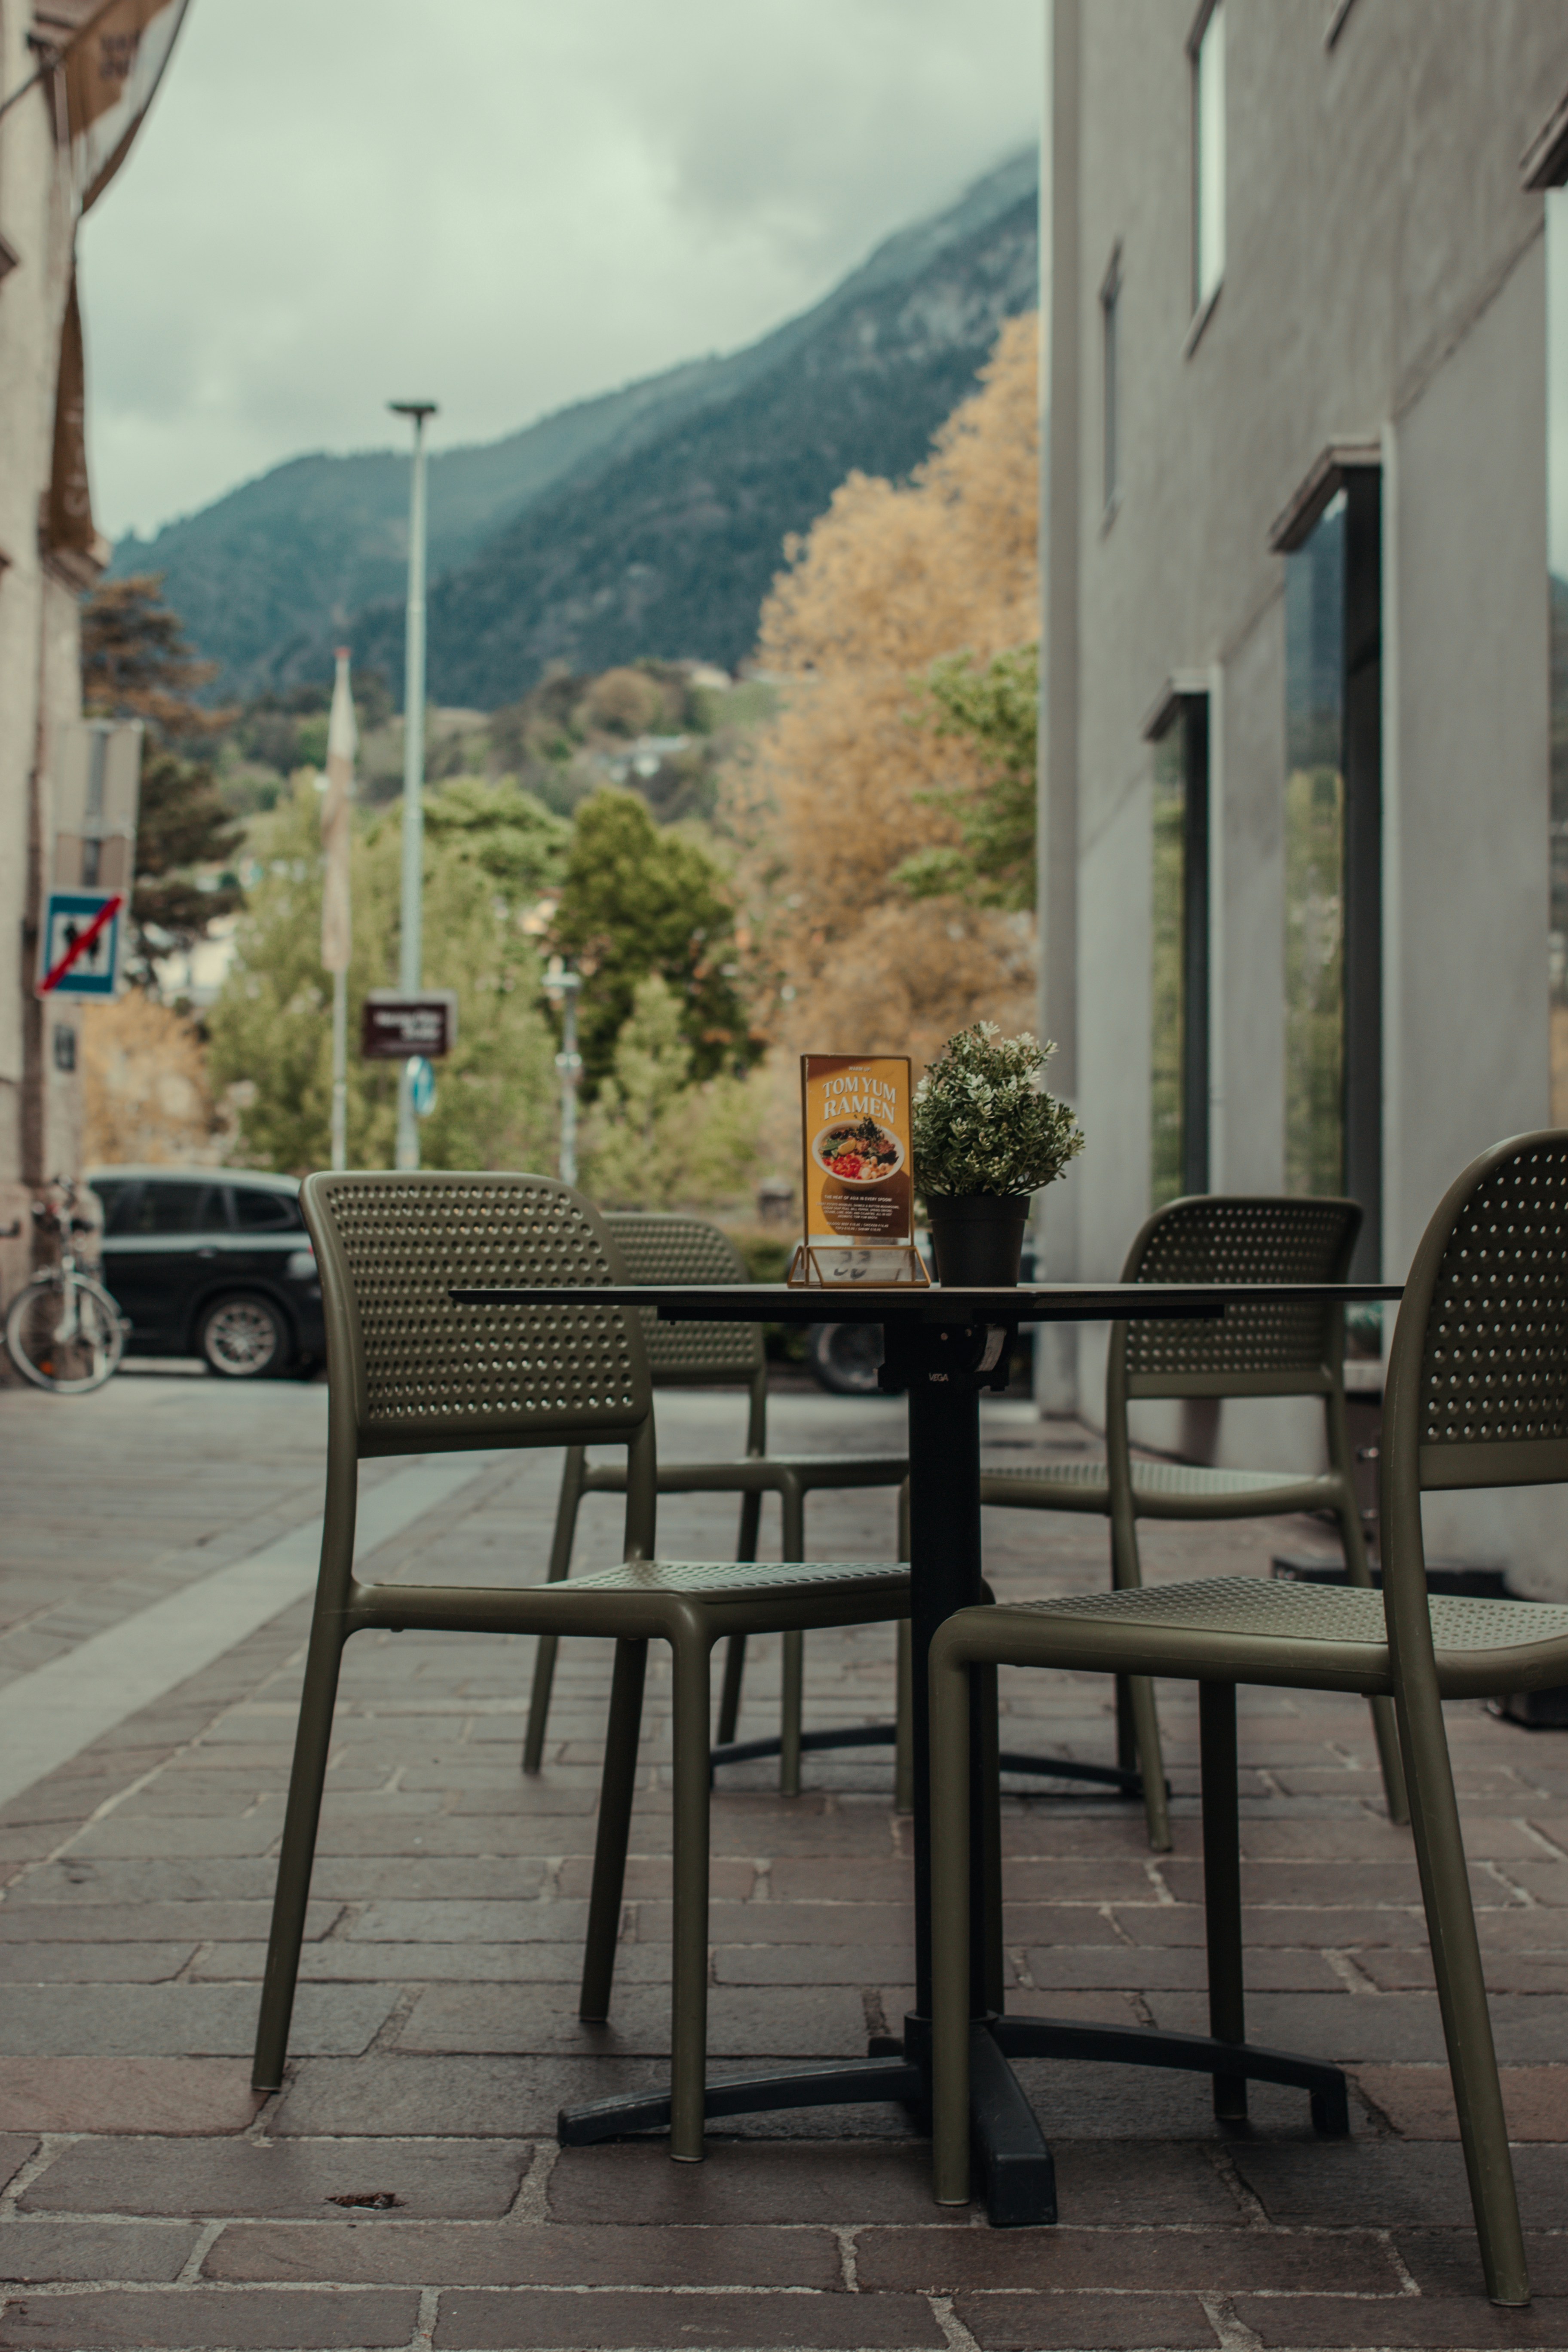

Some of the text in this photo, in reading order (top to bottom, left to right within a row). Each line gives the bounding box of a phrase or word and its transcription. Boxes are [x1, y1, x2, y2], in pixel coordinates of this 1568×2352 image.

[823, 1076, 896, 1104] TOM YUM
[824, 1095, 894, 1124] RAMEN
[929, 1373, 949, 1381] VEGA
